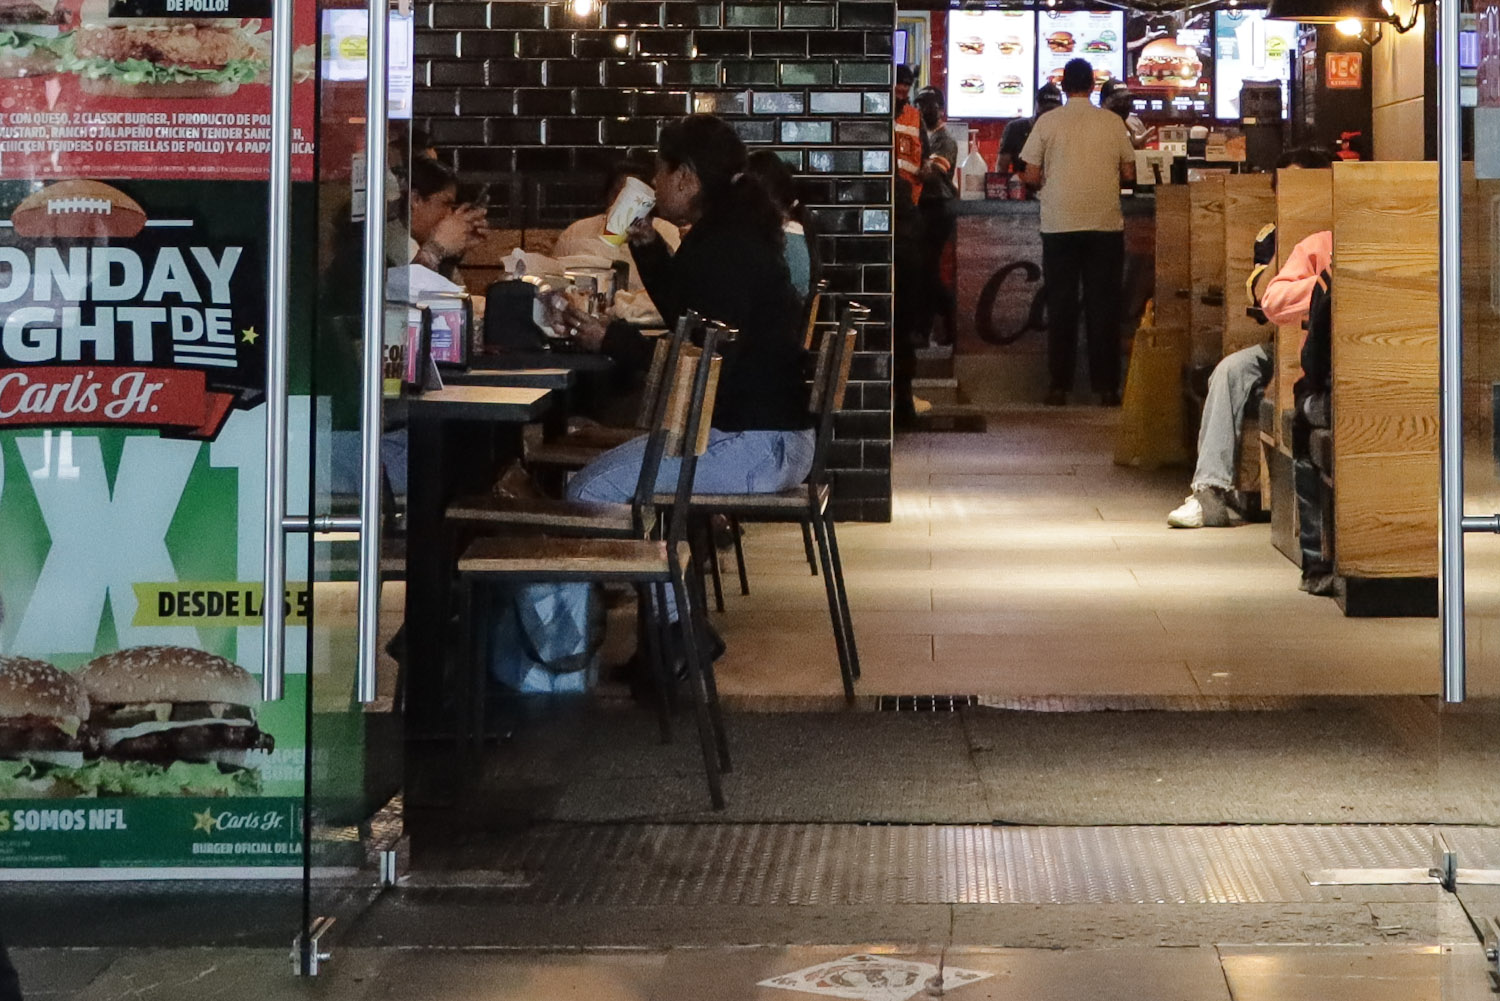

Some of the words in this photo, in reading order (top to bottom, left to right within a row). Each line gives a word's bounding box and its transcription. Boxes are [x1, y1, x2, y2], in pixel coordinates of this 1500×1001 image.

[10, 113, 32, 125] CON
[34, 113, 71, 126] QUESO,
[73, 113, 80, 124] 2
[82, 113, 123, 125] CLASSIC
[125, 113, 170, 127] BURGER,
[178, 113, 234, 126] PRODUCTO
[236, 114, 250, 126] DE
[51, 126, 88, 139] RANCH
[98, 124, 153, 139] JALAPEÑO
[155, 126, 200, 139] CHICKEN
[202, 127, 243, 140] TENDER
[46, 140, 94, 153] TENDERS
[105, 140, 112, 152] 6
[114, 140, 170, 153] ESTRELLAS
[171, 140, 185, 153] DE
[187, 140, 225, 154] POLLO)
[226, 141, 233, 152] Y
[235, 141, 243, 153] 4
[172, 308, 237, 345] DE
[0, 371, 101, 420] Carl's
[105, 371, 159, 420] Jr.
[158, 590, 240, 618] DESDE
[13, 809, 86, 832] SOMOS
[88, 808, 127, 831] NFL
[216, 810, 260, 831] Carl's
[260, 810, 284, 831] Jr.
[192, 842, 234, 854] BURGER
[234, 843, 273, 854] OFICIAL
[274, 843, 288, 854] DE
[289, 843, 303, 854] LA
